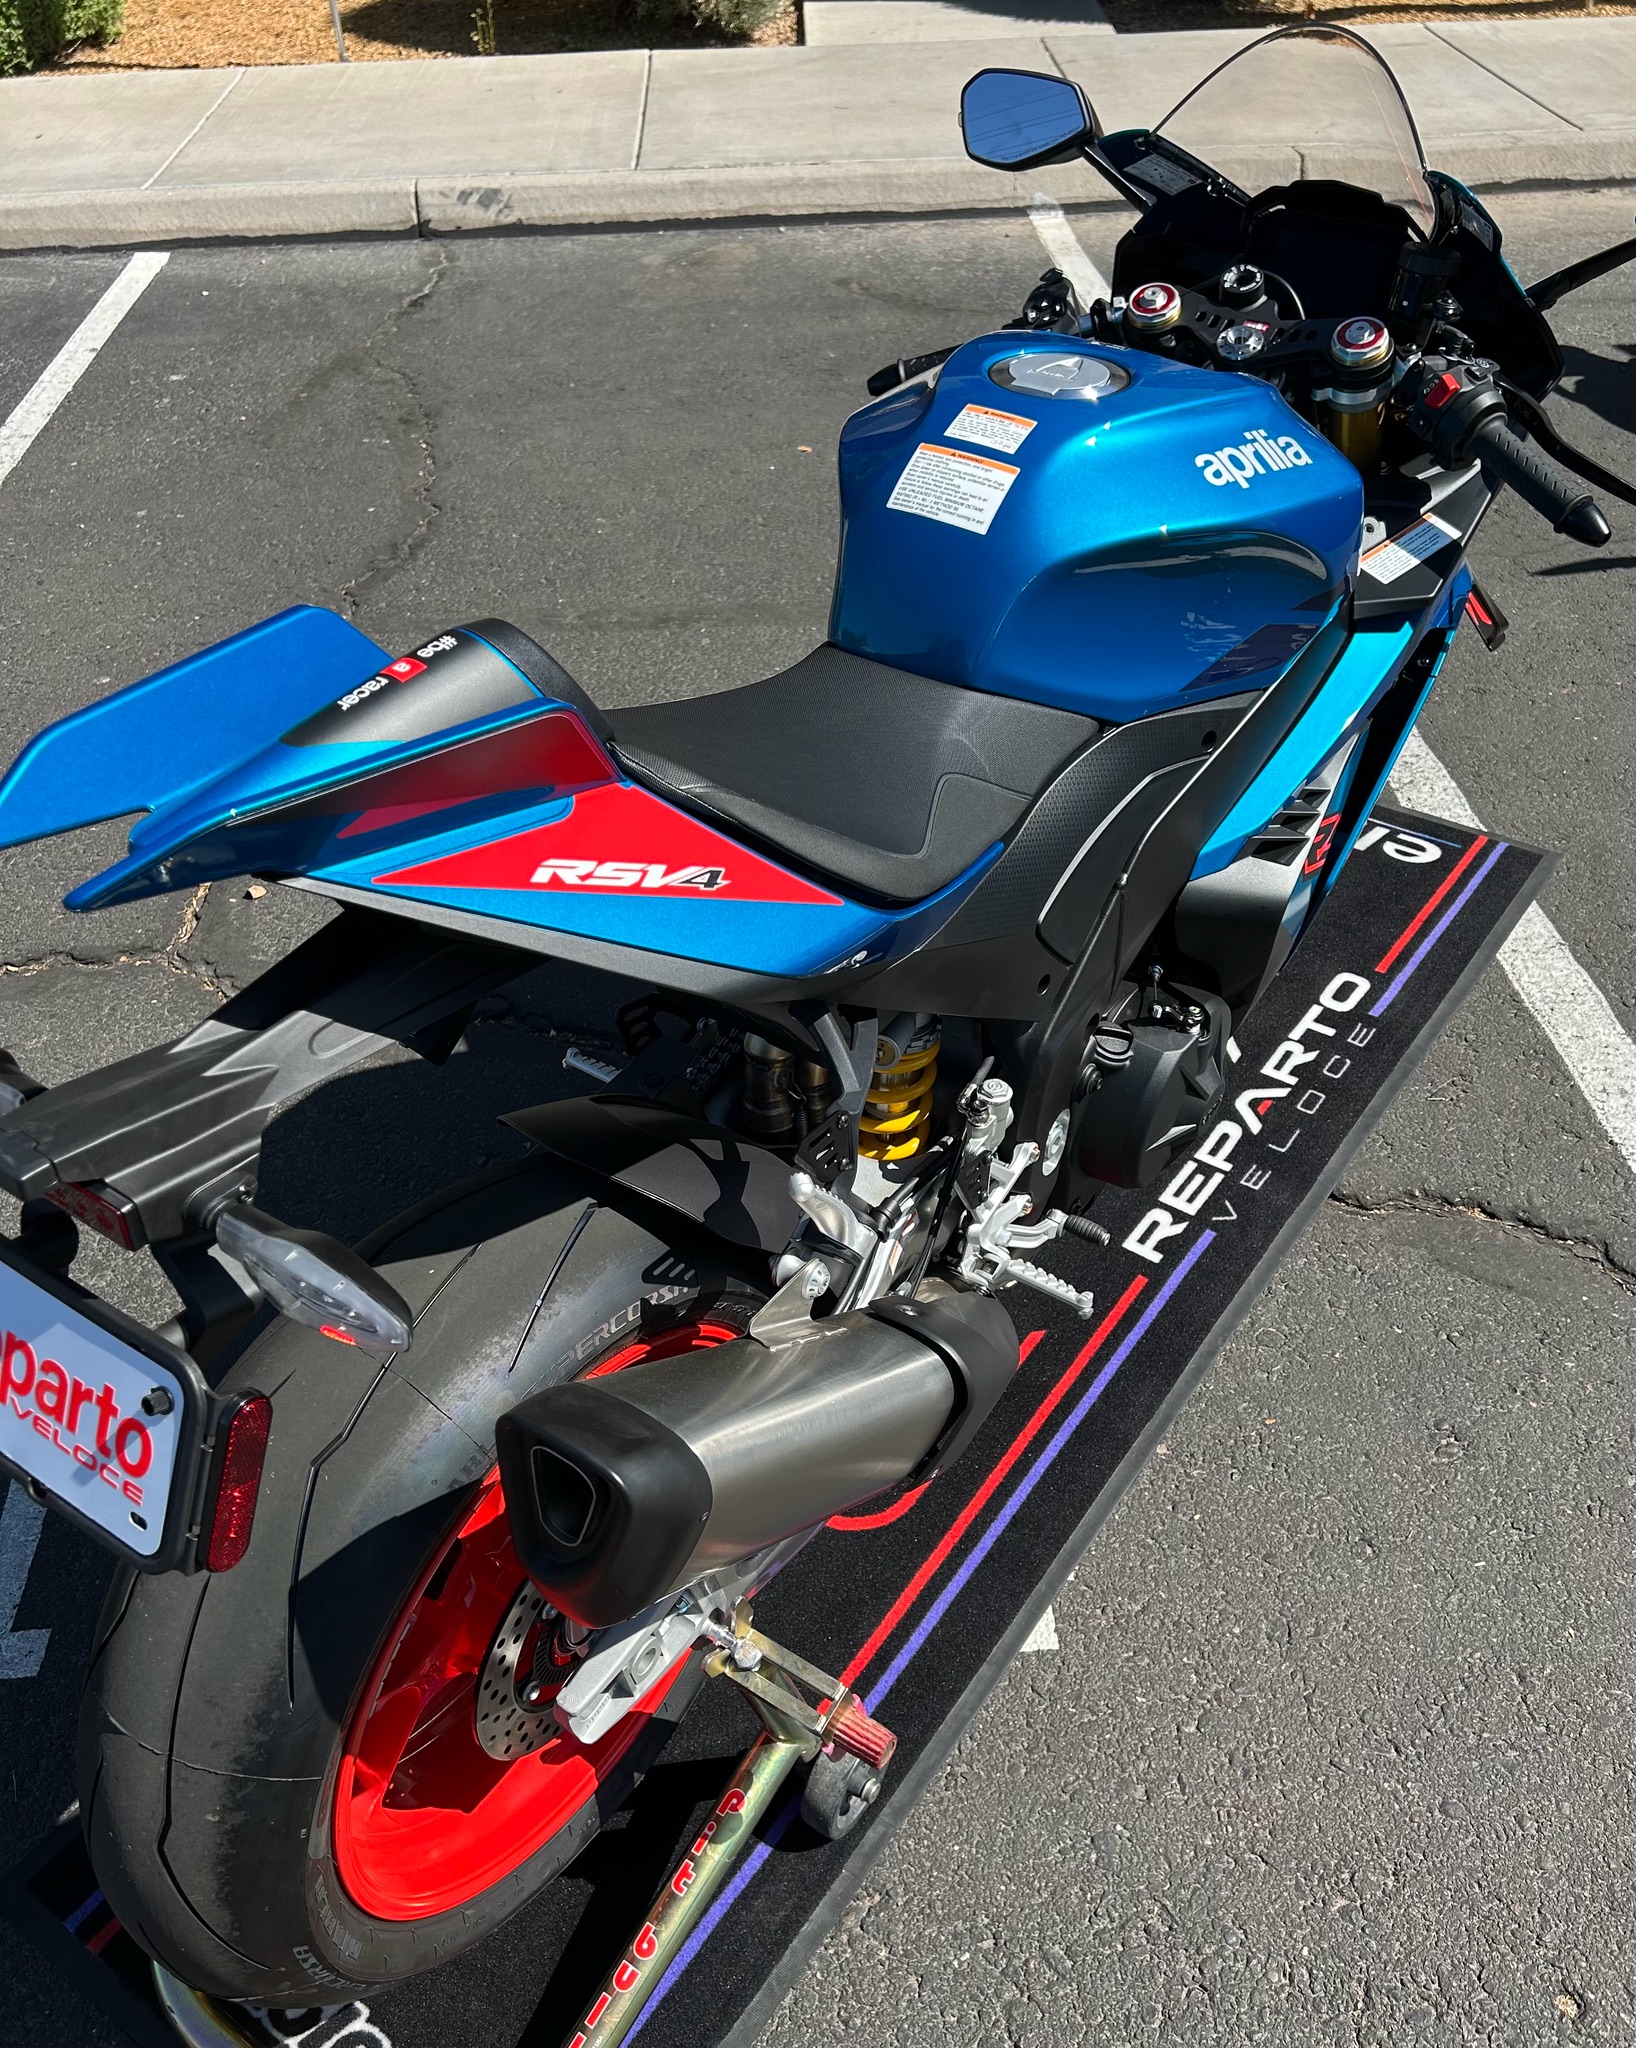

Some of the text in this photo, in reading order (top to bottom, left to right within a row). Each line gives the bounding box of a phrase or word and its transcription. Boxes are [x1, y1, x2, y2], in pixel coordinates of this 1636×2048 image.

[1194, 429, 1314, 489] aprilia
[336, 635, 458, 711] #be a racer
[530, 858, 732, 891] RSV4
[1121, 971, 1371, 1264] REPARTO
[1211, 1021, 1376, 1222] VELOCE
[0, 1330, 154, 1479] parto
[10, 1395, 144, 1507] VELOCE
